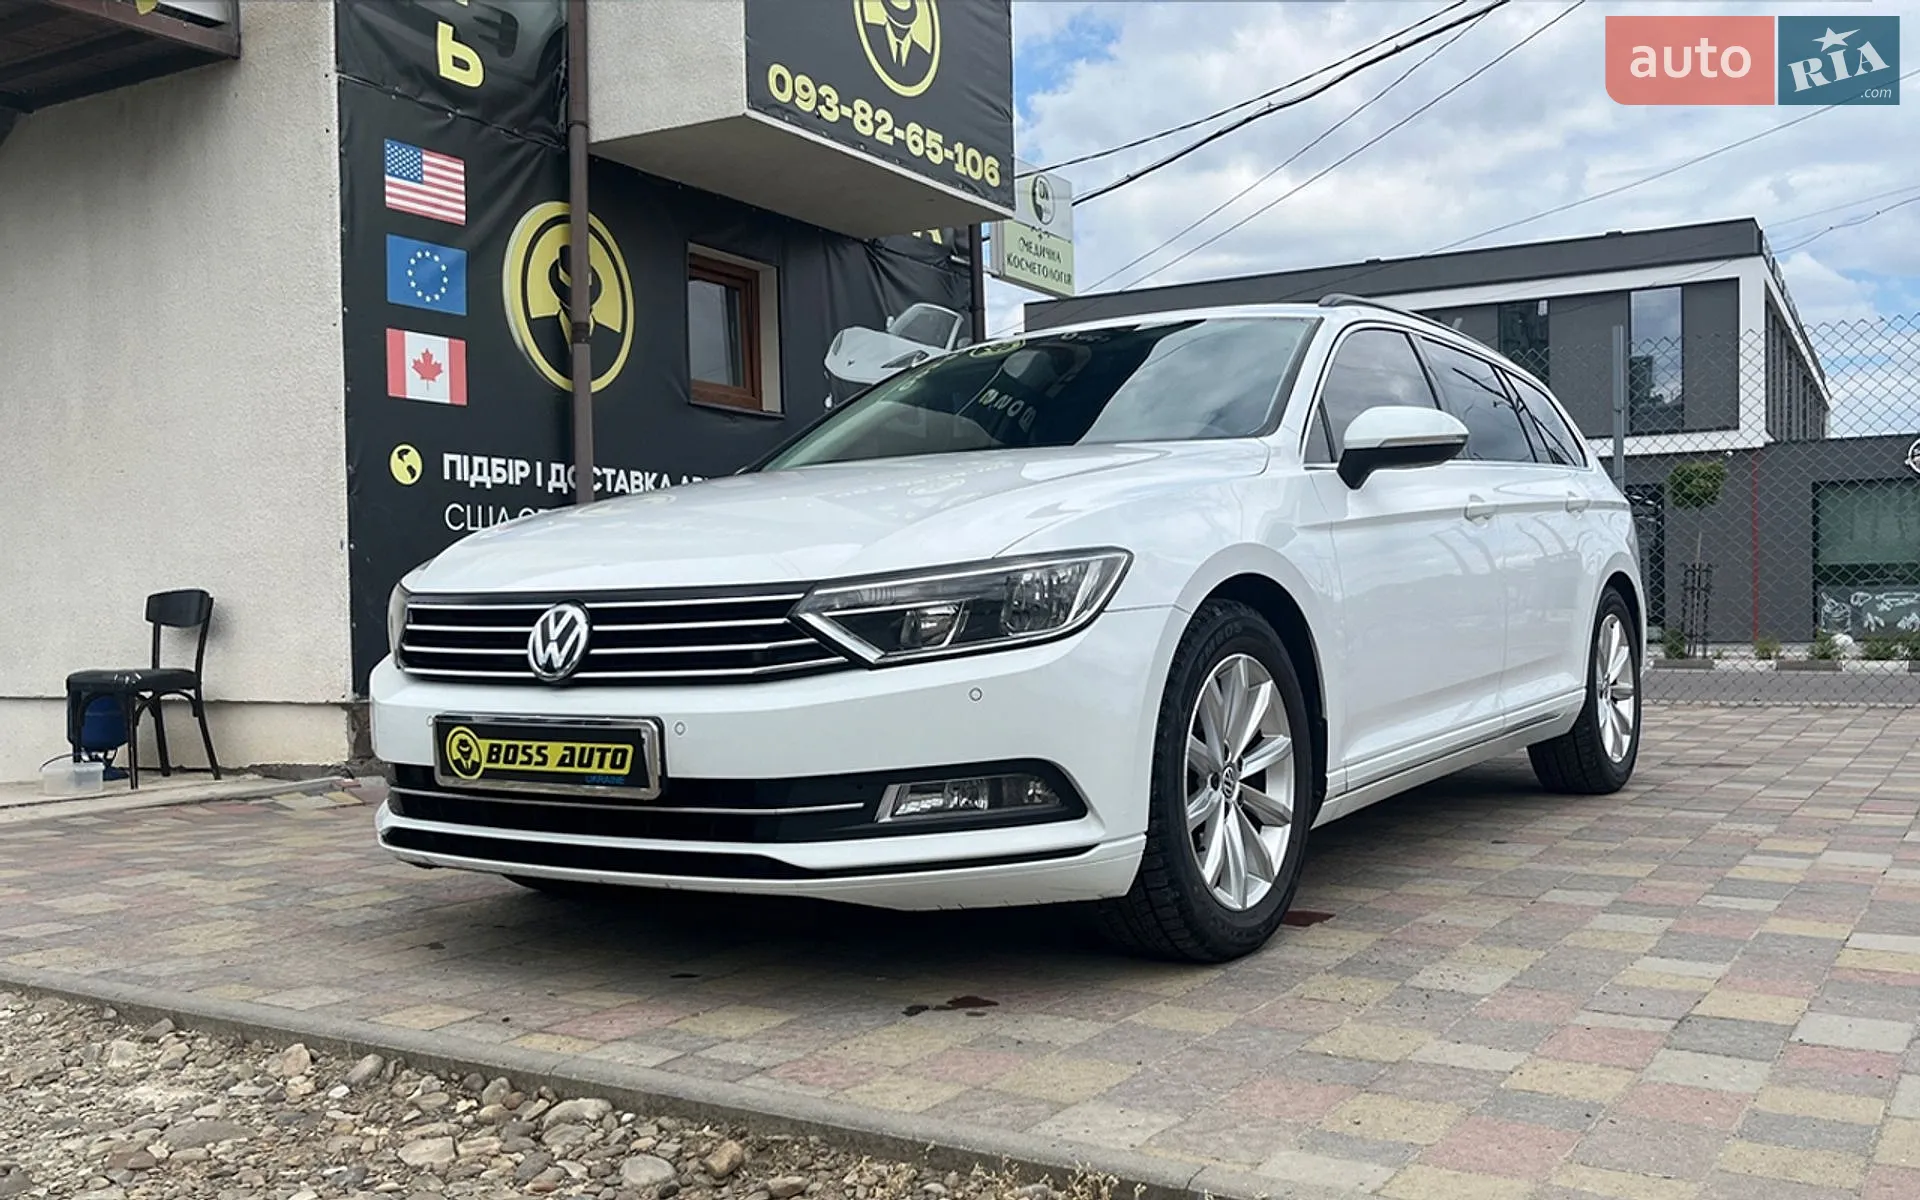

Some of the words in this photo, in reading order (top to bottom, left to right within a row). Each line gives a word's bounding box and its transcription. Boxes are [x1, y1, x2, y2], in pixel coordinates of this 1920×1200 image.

[767, 62, 1001, 188] 093-82-65-106
[443, 453, 531, 489] ПІДБІР
[536, 460, 543, 488] І
[530, 605, 586, 676] VW
[486, 742, 549, 767] BOSS
[556, 745, 629, 770] AUTO
